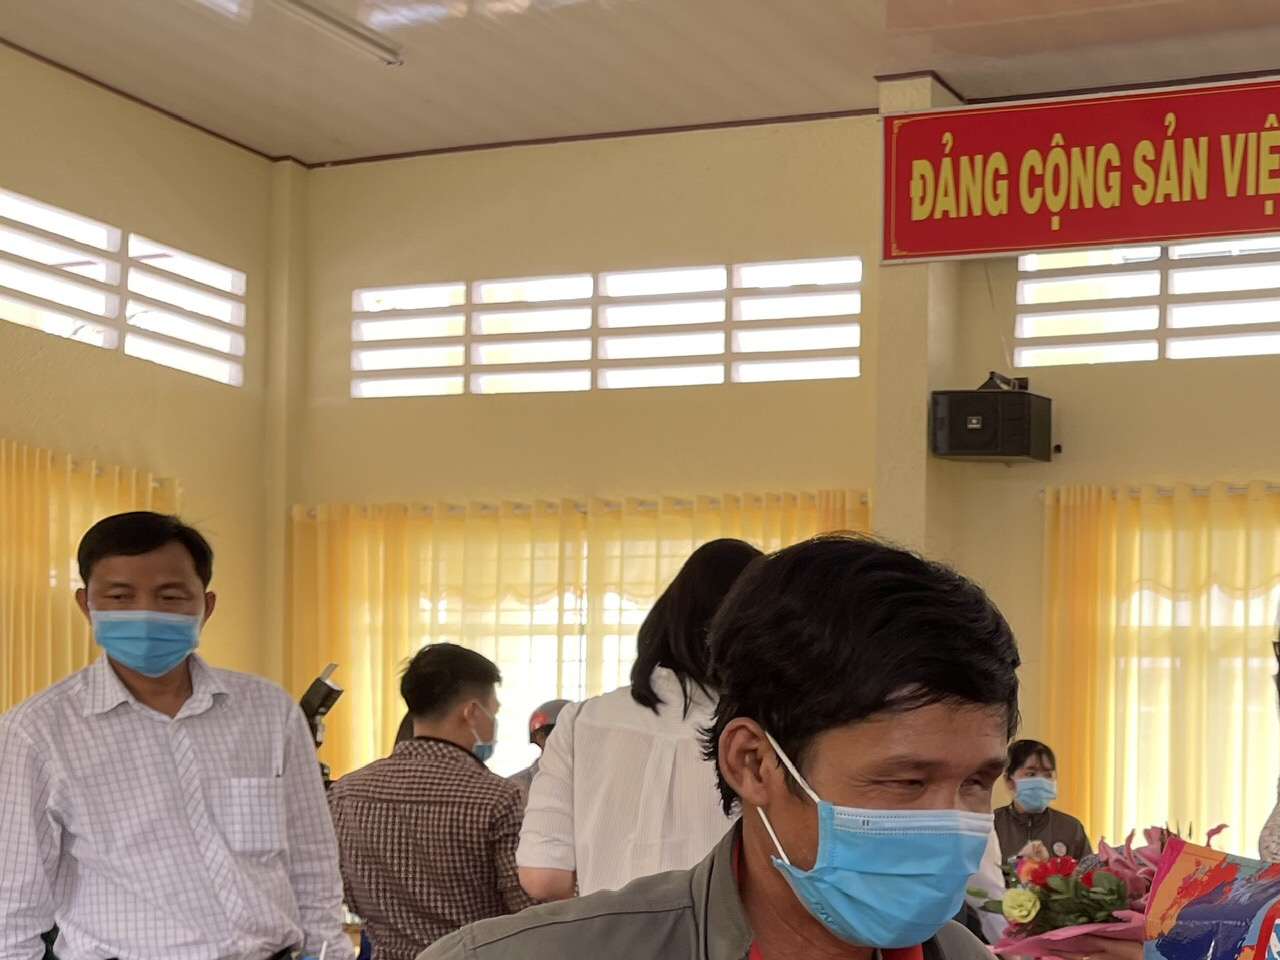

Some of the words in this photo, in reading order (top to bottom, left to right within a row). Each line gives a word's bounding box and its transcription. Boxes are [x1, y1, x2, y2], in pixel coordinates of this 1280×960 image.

[909, 131, 1009, 221] ĐẢNG
[1018, 132, 1122, 231] CỘNG
[1131, 112, 1209, 207] SẢN
